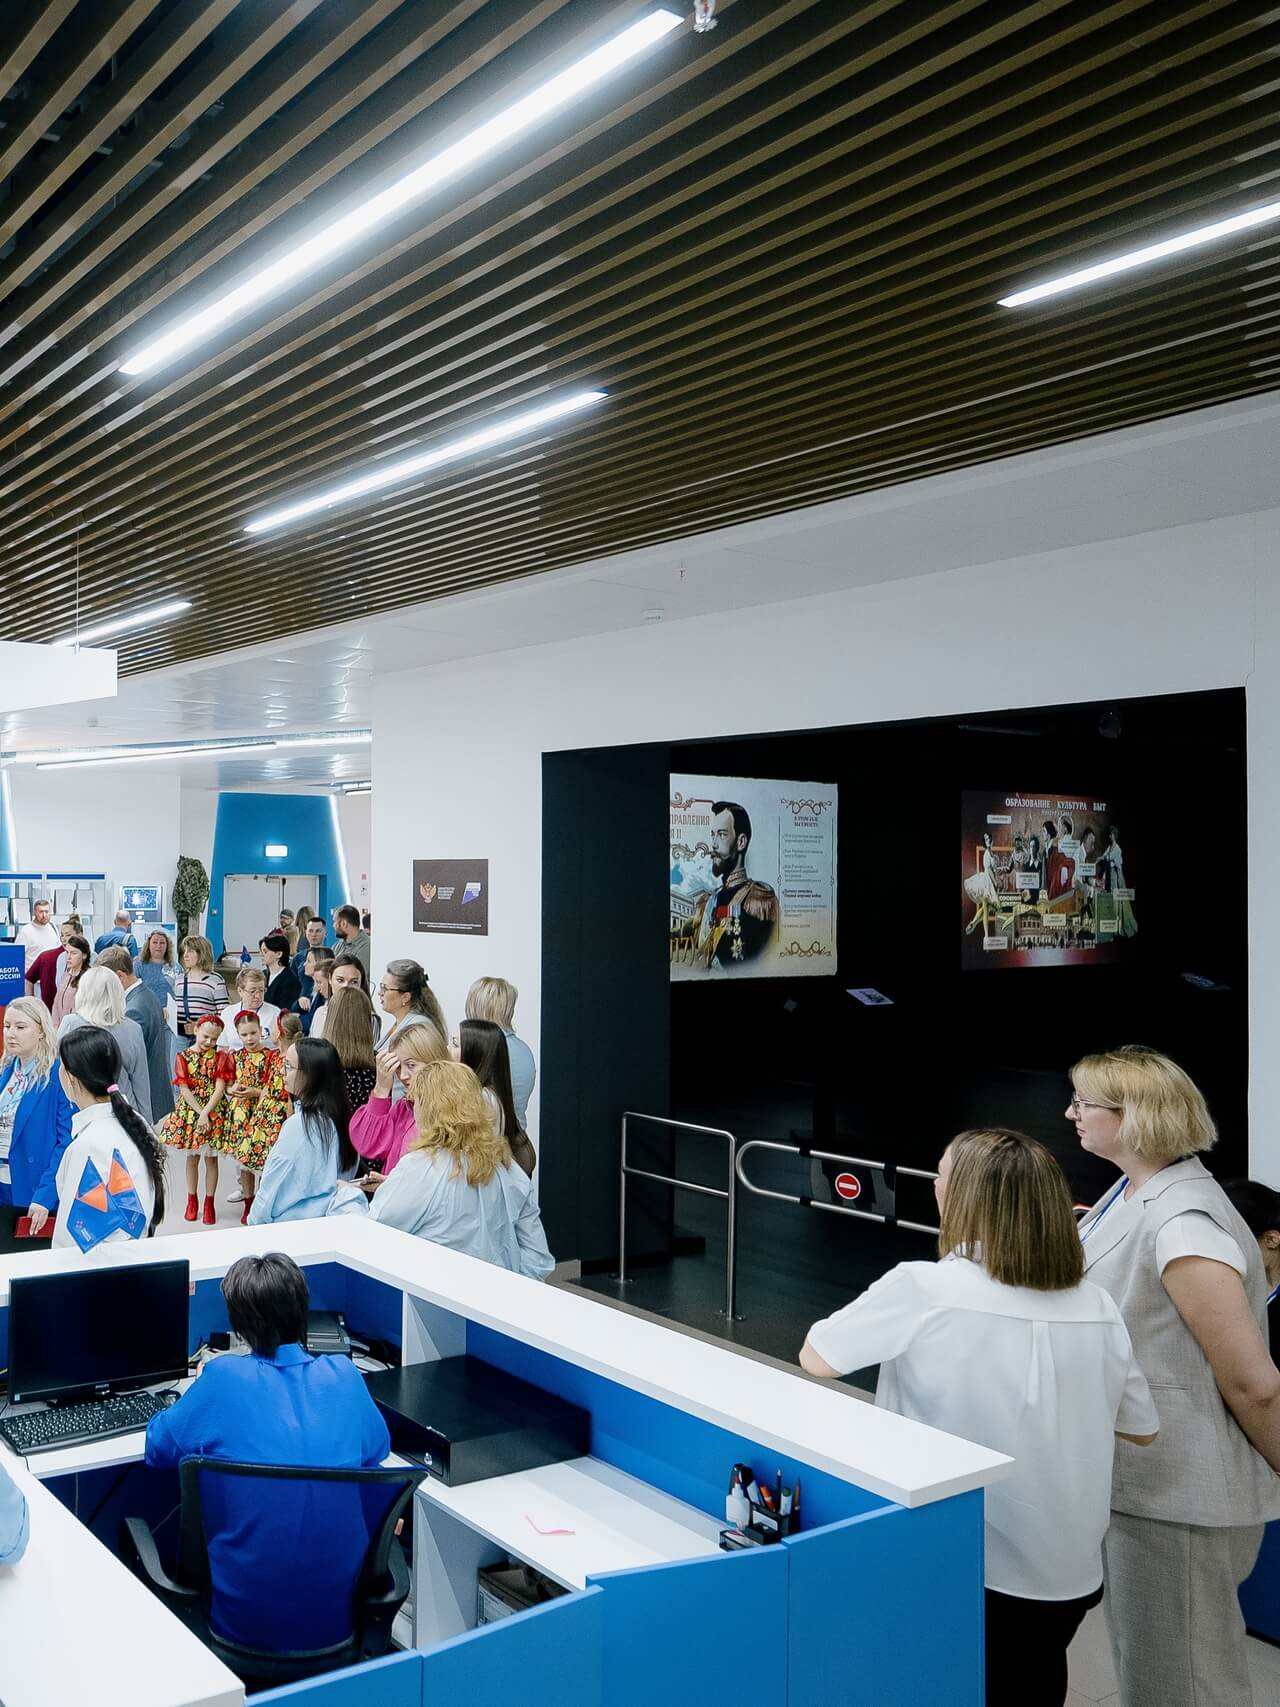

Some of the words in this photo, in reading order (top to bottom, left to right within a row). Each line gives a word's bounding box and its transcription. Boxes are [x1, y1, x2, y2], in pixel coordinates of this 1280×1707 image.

[1005, 798, 1050, 809] ОБРАЗОВАНИЕ
[1056, 801, 1087, 811] КУЛЬТУРА
[1093, 802, 1107, 812] БЫТ
